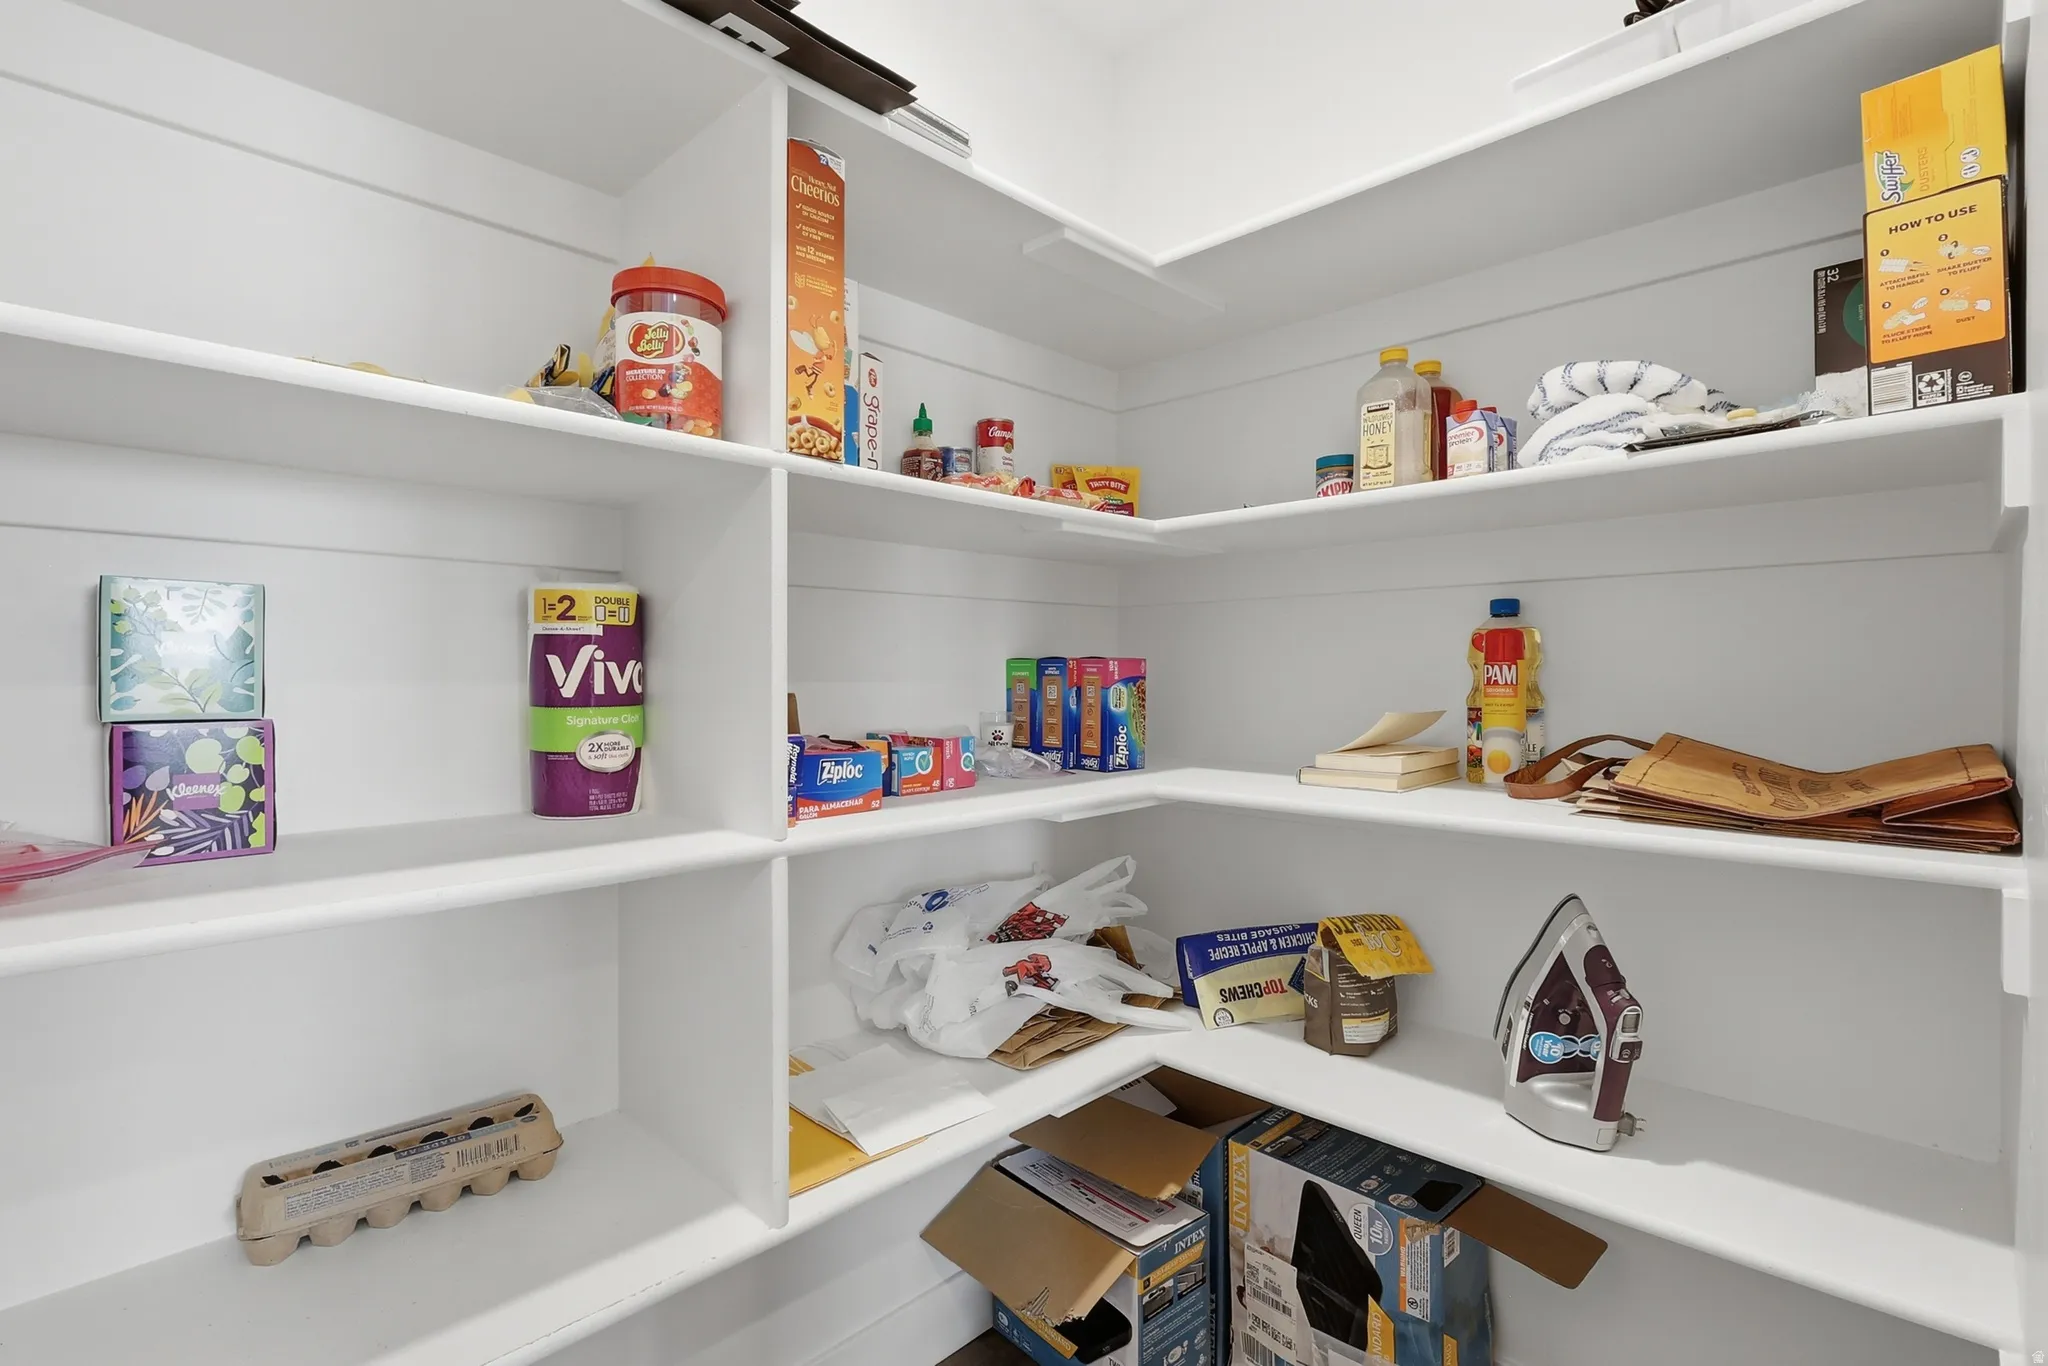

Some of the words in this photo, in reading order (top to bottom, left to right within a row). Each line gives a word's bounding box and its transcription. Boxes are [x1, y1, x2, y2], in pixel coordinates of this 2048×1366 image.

[1881, 151, 1907, 202] Swiffer
[791, 175, 840, 207] Cheerios
[1888, 219, 1922, 235] HOW
[1925, 213, 1945, 225] TO
[1948, 204, 1978, 219] USE
[1826, 267, 1840, 283] 32
[644, 325, 670, 342] Jelly
[637, 339, 665, 353] Belly
[625, 373, 663, 382] COLLECTION
[1362, 420, 1393, 437] HONEY
[1448, 438, 1472, 448] protein
[1089, 480, 1110, 488] TASTY
[1110, 480, 1128, 491] BITE
[594, 596, 630, 606] DOUBLE
[1483, 664, 1517, 685] PAM
[566, 715, 619, 727] Signature
[587, 742, 604, 753] 2X
[1115, 725, 1130, 766] Ziploc
[593, 752, 607, 760] soft
[789, 744, 801, 784] Reynolds
[821, 761, 863, 784] Ziploc
[165, 782, 230, 801] Kleenex
[799, 805, 820, 814] PARA
[821, 798, 864, 811] ALMACENAR
[871, 800, 880, 808] 52
[1216, 932, 1248, 942] BITES
[1250, 924, 1301, 939] SAUSAGE
[1242, 940, 1269, 956] APPLE
[1268, 938, 1278, 950] &
[1279, 931, 1318, 950] CHICKEN
[1207, 945, 1241, 961] RECIPE
[1541, 1039, 1553, 1057] Year
[1549, 1043, 1561, 1057] 10
[1230, 1153, 1248, 1226] INTEX
[1353, 1208, 1362, 1240] QUEEN
[1369, 1219, 1383, 1245] 10in
[1174, 1225, 1207, 1255] INTEX
